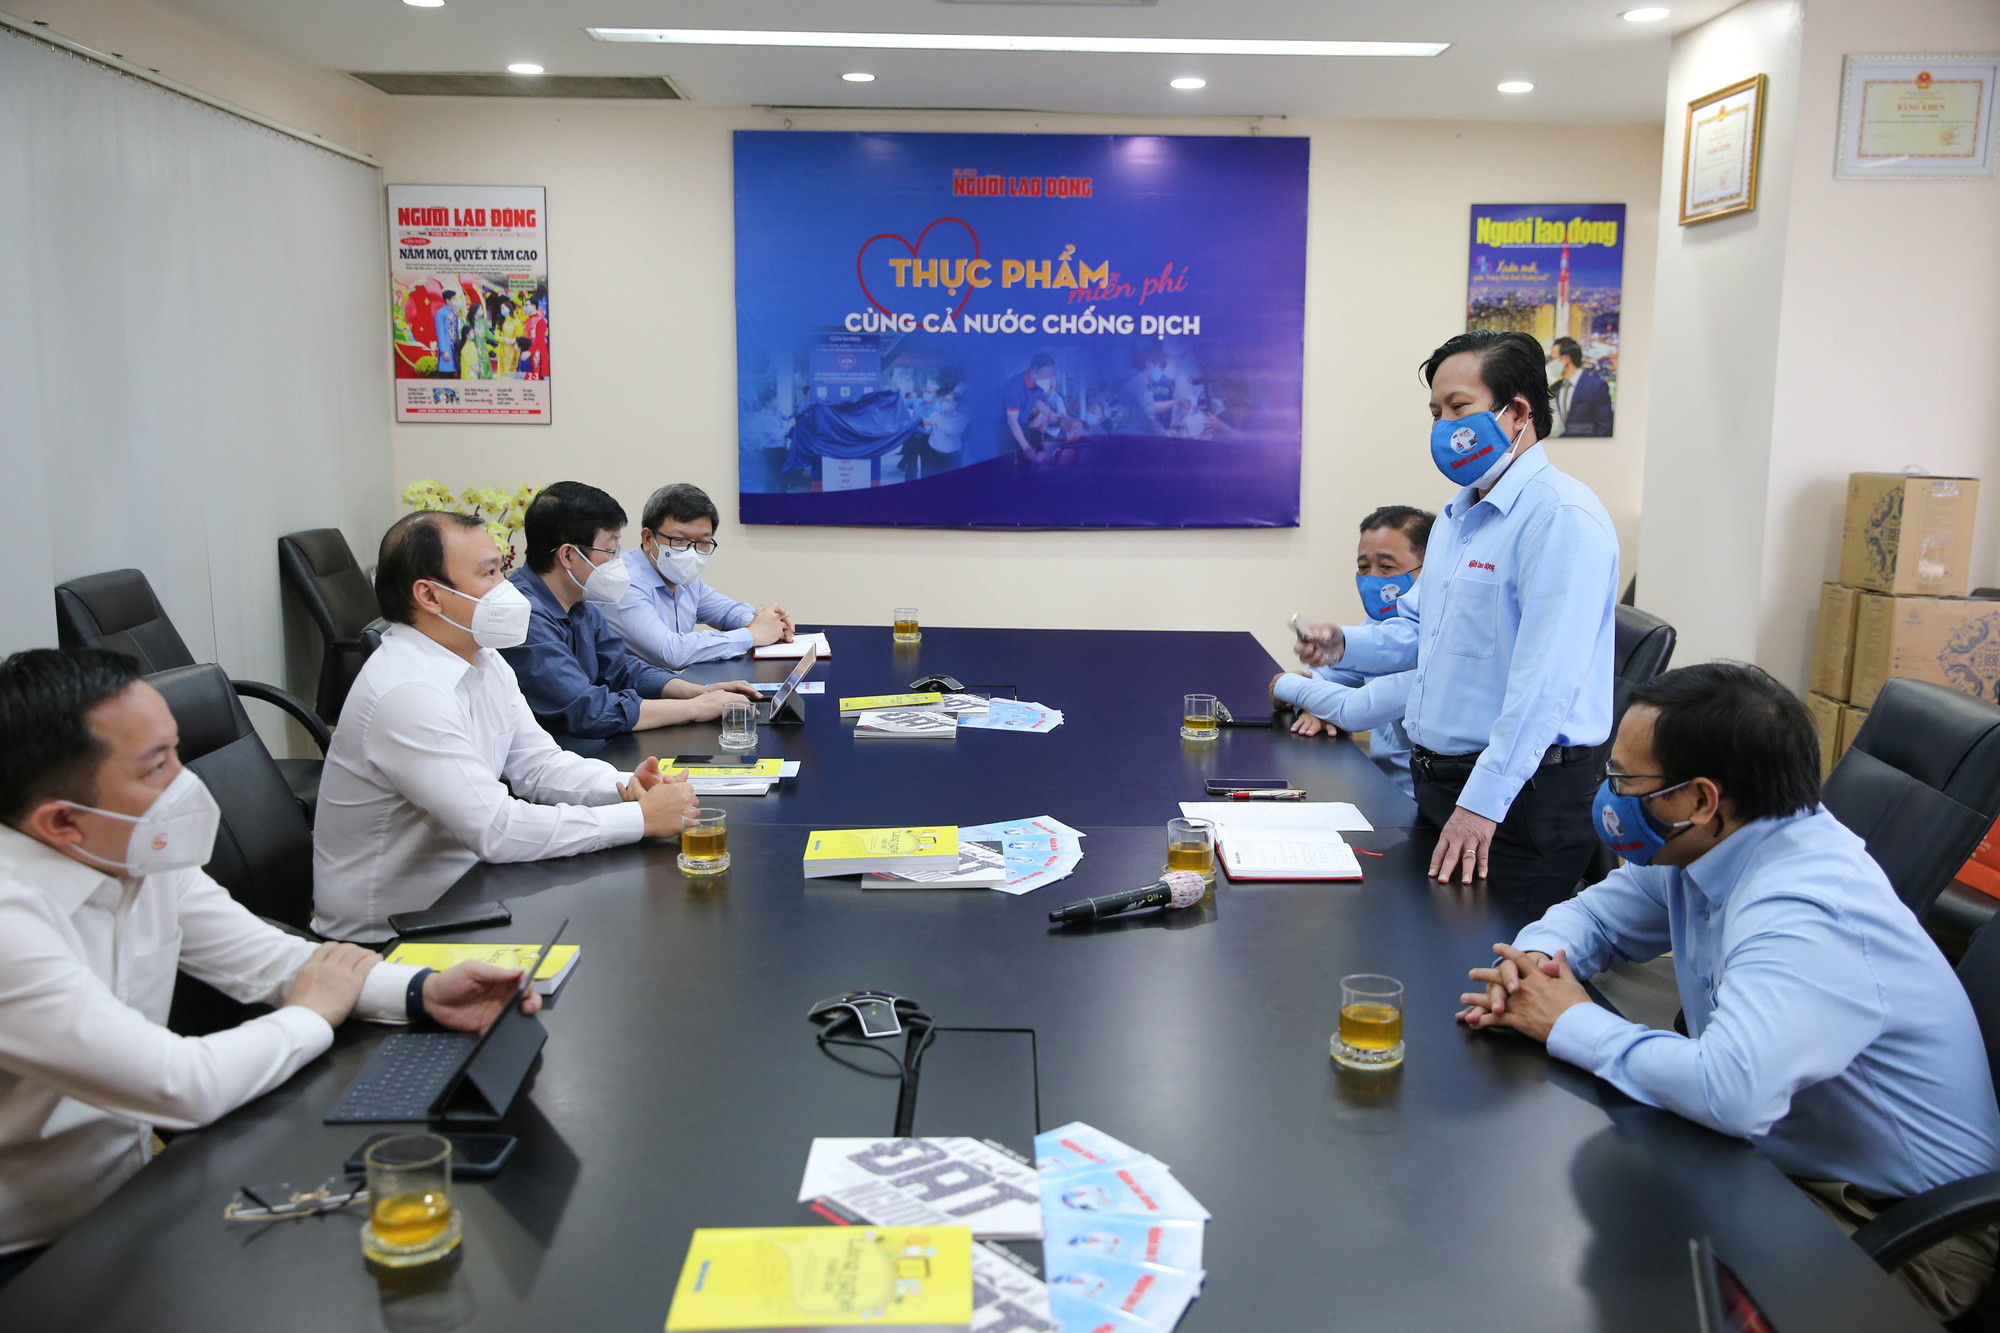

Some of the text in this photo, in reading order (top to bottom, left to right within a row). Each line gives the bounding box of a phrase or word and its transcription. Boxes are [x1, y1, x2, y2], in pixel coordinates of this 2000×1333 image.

[953, 175, 1092, 198] NGƯỜI LAO ĐỘNG
[398, 206, 536, 228] NGƯỜI LAO ĐỘNG
[1476, 217, 1618, 247] Người lao động
[399, 246, 538, 262] NĂM MỚI, QUYẾT TÂM CAO
[889, 243, 1189, 305] THỰC PHẨM miễn phí
[845, 306, 1200, 340] CÙNG CẢ NƯỚC CHỐNG DỊCH
[528, 372, 539, 380] 2-3
